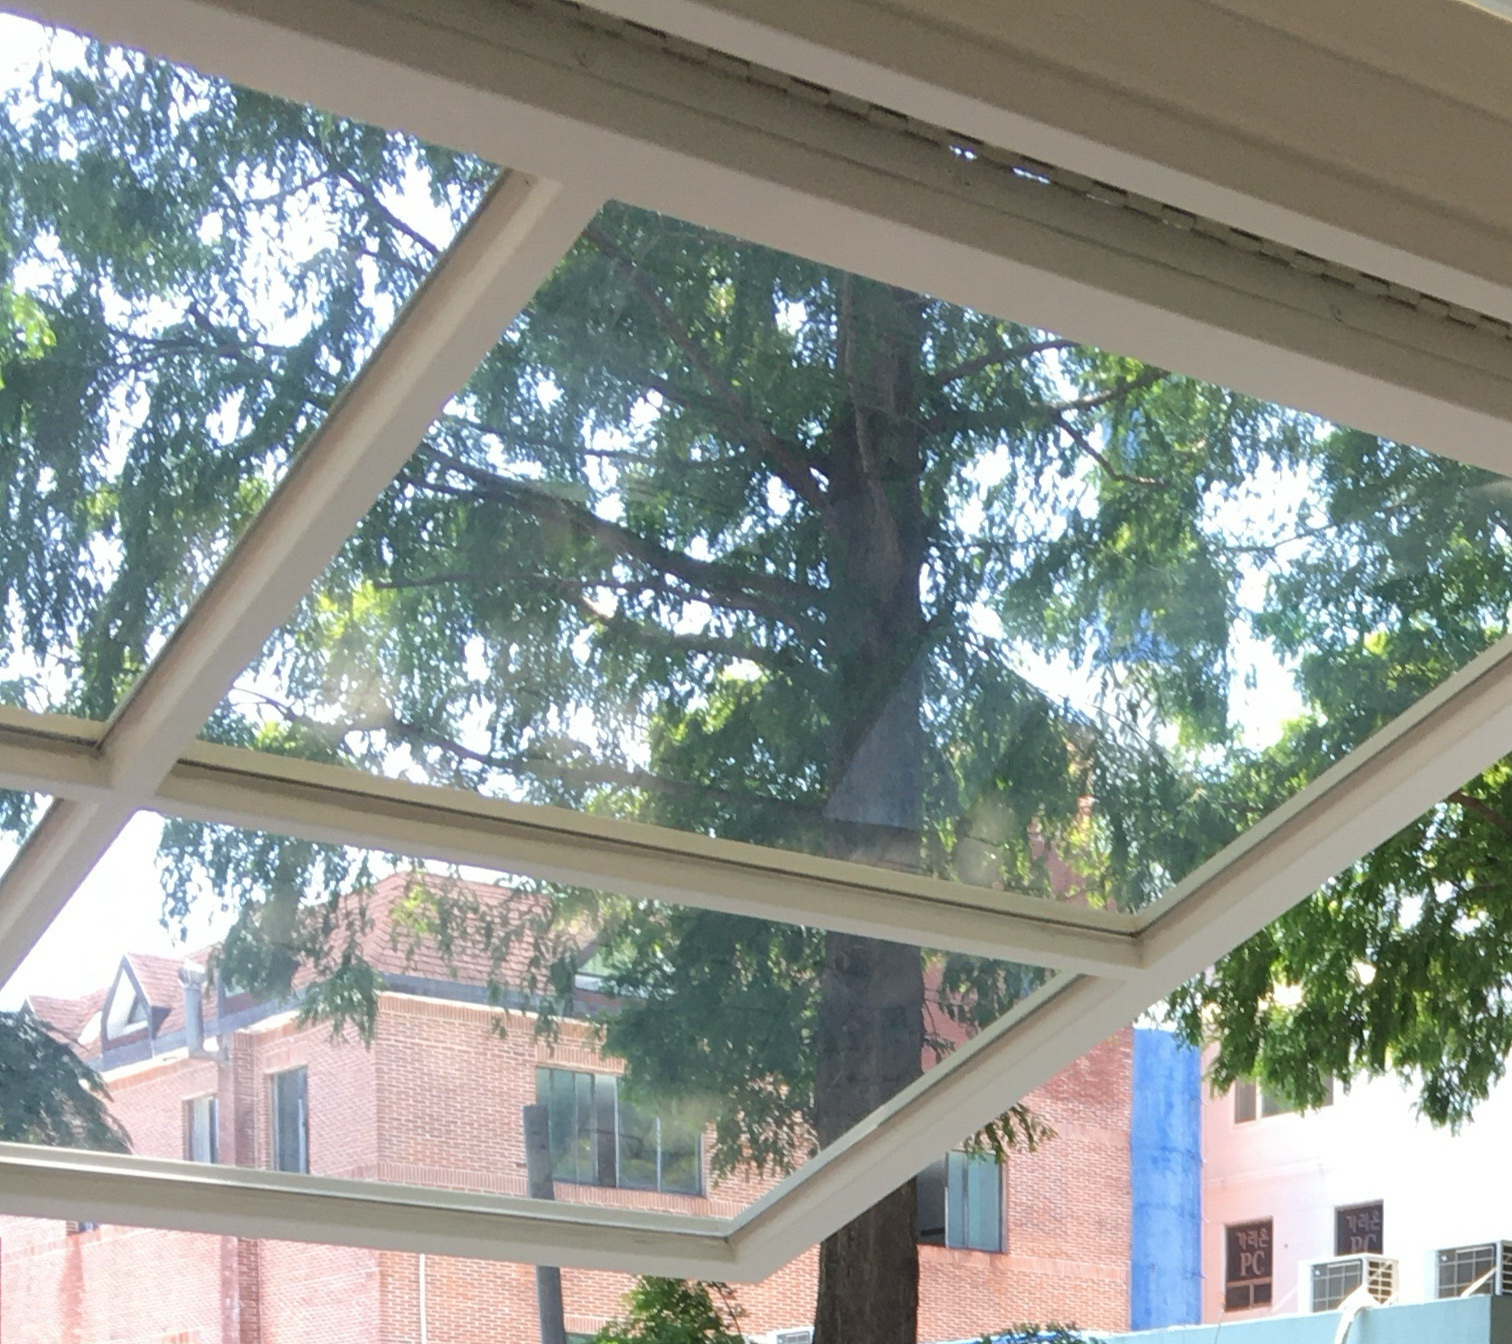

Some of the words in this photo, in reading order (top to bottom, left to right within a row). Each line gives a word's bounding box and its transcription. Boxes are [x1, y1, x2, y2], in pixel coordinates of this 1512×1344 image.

[1346, 1209, 1381, 1233] 가리온
[1236, 1227, 1270, 1250] 가리온
[1350, 1233, 1377, 1253] PC
[1239, 1250, 1266, 1277] PC
